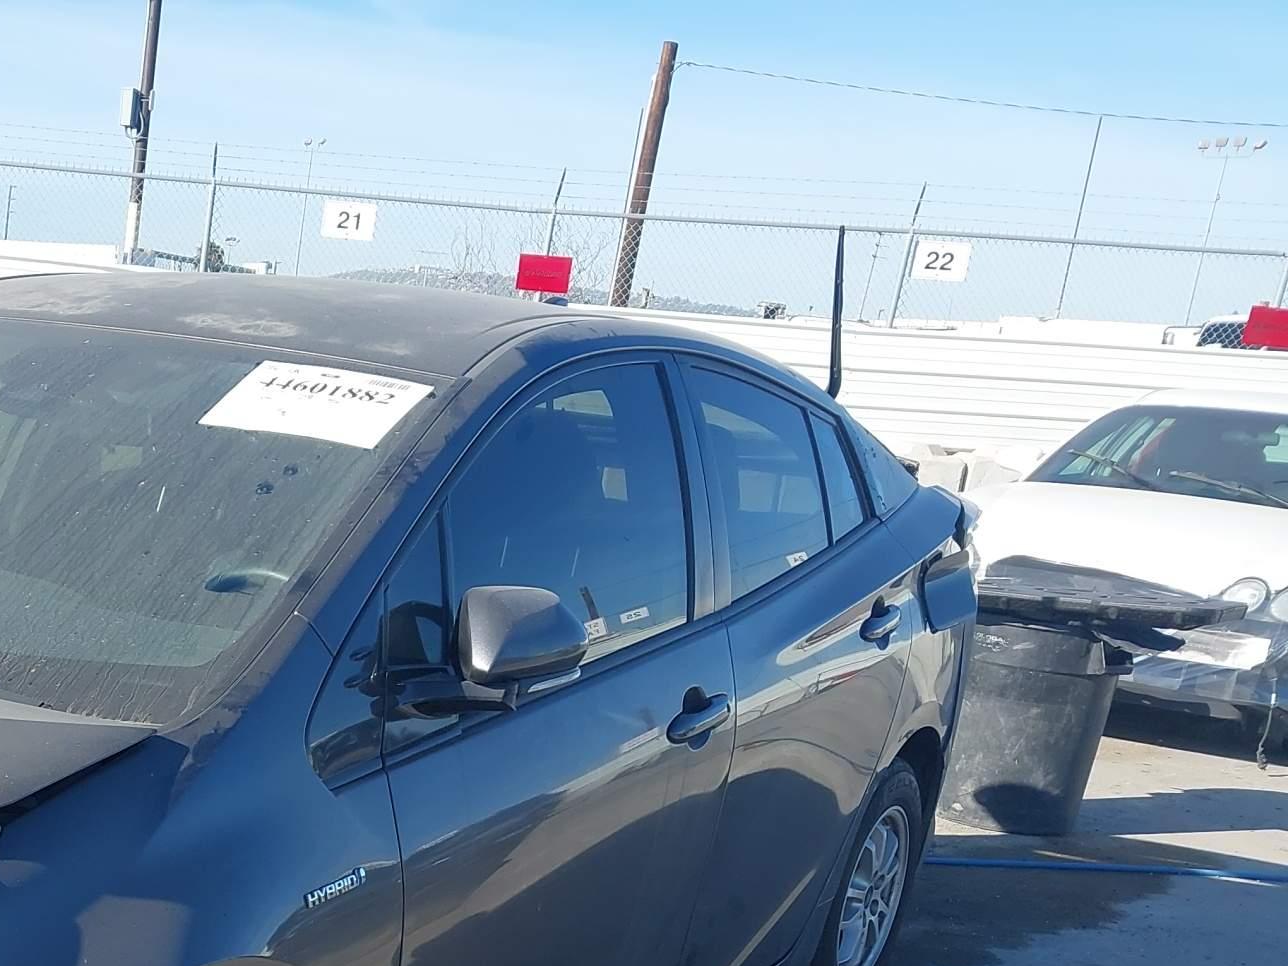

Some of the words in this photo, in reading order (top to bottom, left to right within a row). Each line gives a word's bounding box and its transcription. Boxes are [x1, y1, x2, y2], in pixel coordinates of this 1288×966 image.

[336, 211, 361, 230] 21
[924, 251, 954, 271] 22
[260, 376, 396, 405] 44601882
[307, 874, 360, 908] HYBRID
